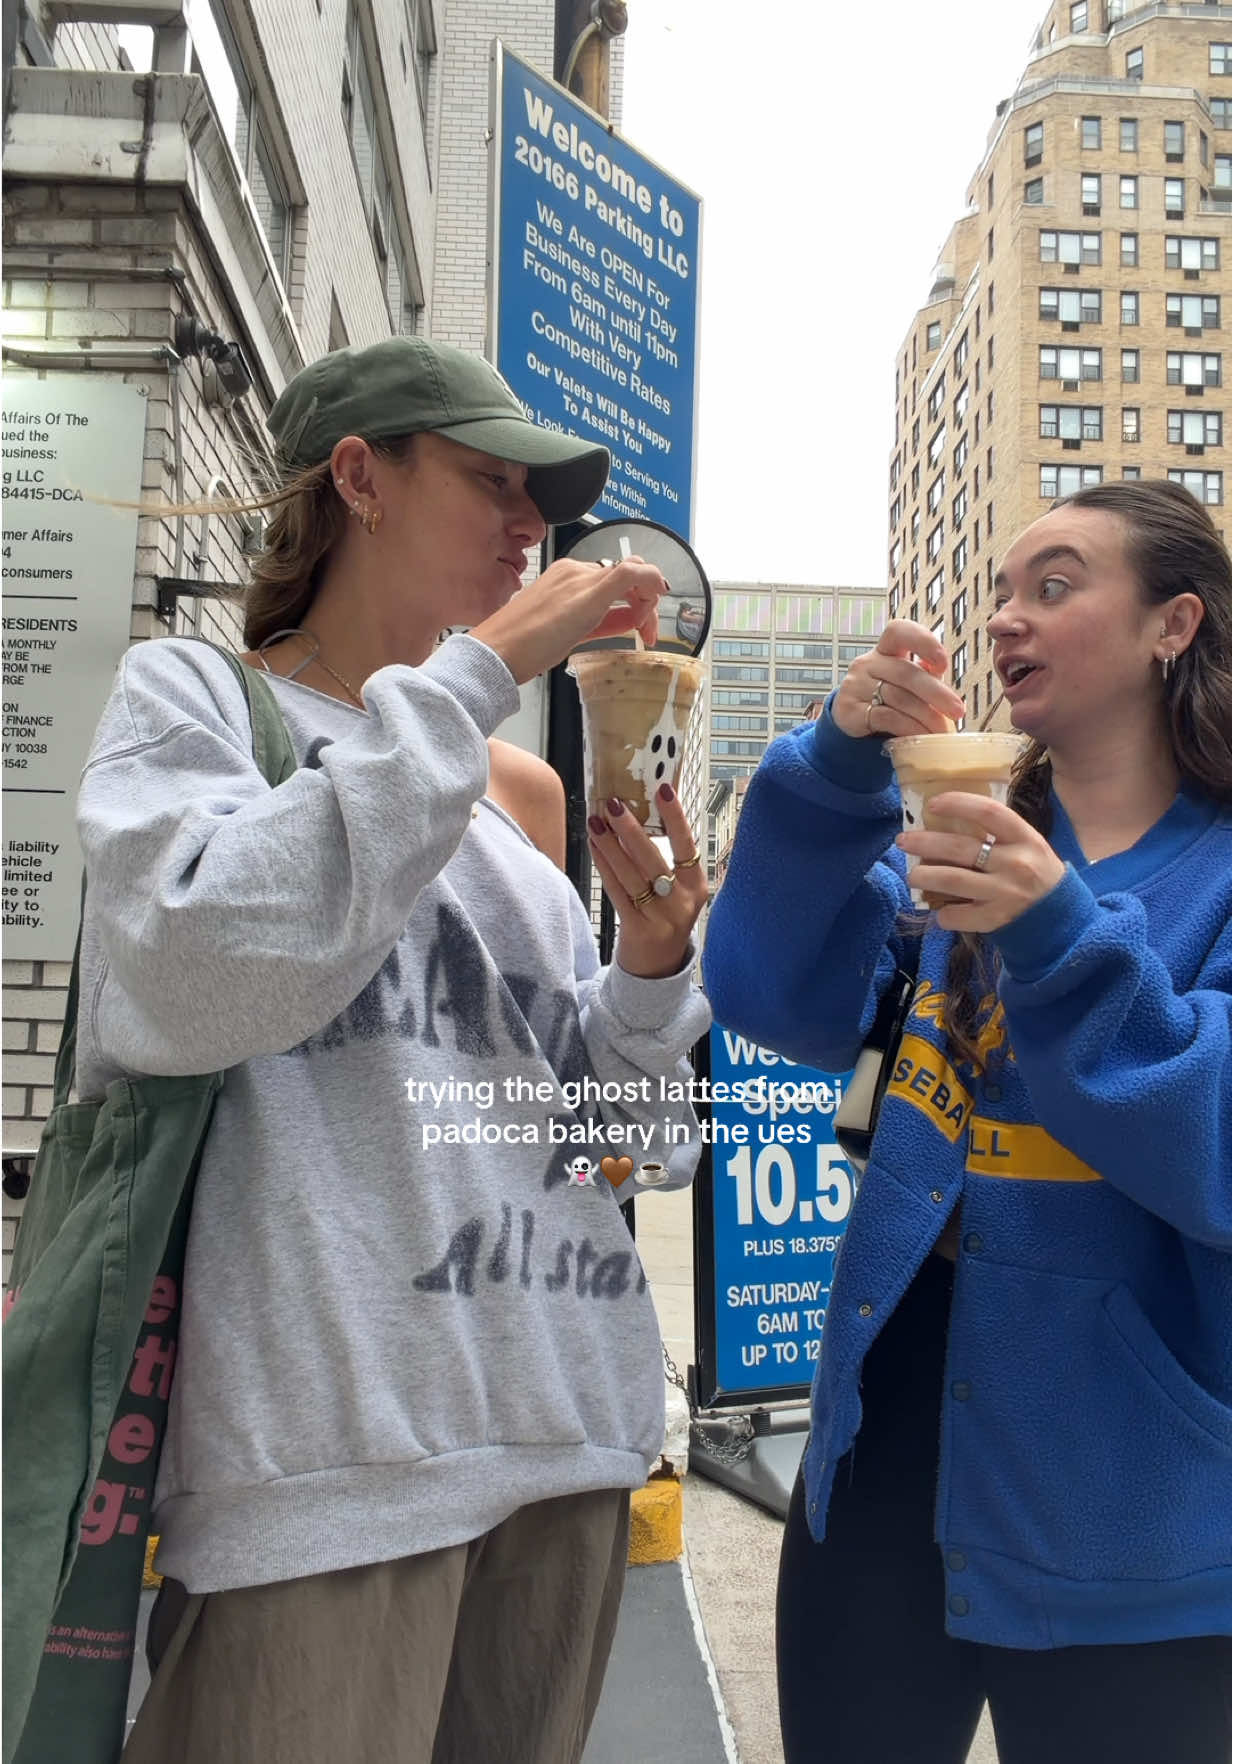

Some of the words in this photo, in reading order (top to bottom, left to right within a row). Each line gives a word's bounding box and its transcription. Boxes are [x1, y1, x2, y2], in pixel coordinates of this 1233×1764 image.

[523, 87, 652, 215] Welcome
[659, 194, 684, 238] to
[514, 135, 580, 201] 20166
[584, 184, 653, 259] Parking
[657, 237, 690, 279] LLC
[536, 199, 564, 236] We
[568, 225, 597, 259] Are
[600, 247, 644, 293] OPEN
[646, 278, 671, 310] For
[525, 221, 601, 289] Business
[603, 275, 647, 322] Every
[650, 307, 678, 344] Day
[523, 249, 568, 295] From
[570, 281, 607, 321] 6am
[610, 311, 642, 344] until
[644, 330, 679, 369] 11pm
[569, 305, 606, 346] With
[608, 330, 643, 371] Very
[531, 310, 628, 387] Competitive
[629, 372, 672, 416] Rates
[526, 351, 552, 379] Our
[553, 367, 594, 404] Valets
[596, 393, 618, 420] Will
[620, 408, 636, 430] Be
[637, 418, 672, 455] Happy
[2, 411, 41, 425] Affairs
[45, 412, 62, 425] Of
[65, 413, 89, 426] The
[562, 394, 579, 417] To
[581, 406, 620, 442] Assist
[621, 429, 643, 456] You
[29, 429, 49, 442] the
[16, 469, 44, 482] LLC
[611, 453, 622, 470] to
[624, 461, 661, 495] Serving
[661, 482, 679, 504] You
[619, 483, 647, 508] Within
[31, 529, 73, 542] Affairs
[2, 567, 73, 580] consumers
[2, 617, 78, 632] RESIDENTS
[8, 639, 57, 650] MONTHLY
[15, 651, 30, 661] BE
[30, 663, 52, 674] THE
[6, 715, 54, 727] FINANCE
[2, 727, 36, 738] CTION
[15, 743, 48, 754] 10038
[9, 840, 60, 855] liability
[2, 855, 43, 868] ehicle
[4, 869, 53, 882] limited
[24, 887, 40, 897] or
[24, 900, 40, 911] to
[722, 1030, 800, 1067] We
[726, 1143, 852, 1226] 10.5
[743, 1239, 785, 1257] PLUS
[726, 1280, 832, 1308] SATURDAY-
[756, 1311, 799, 1336] 6AM
[741, 1345, 768, 1367] UP
[772, 1341, 799, 1364] TO
